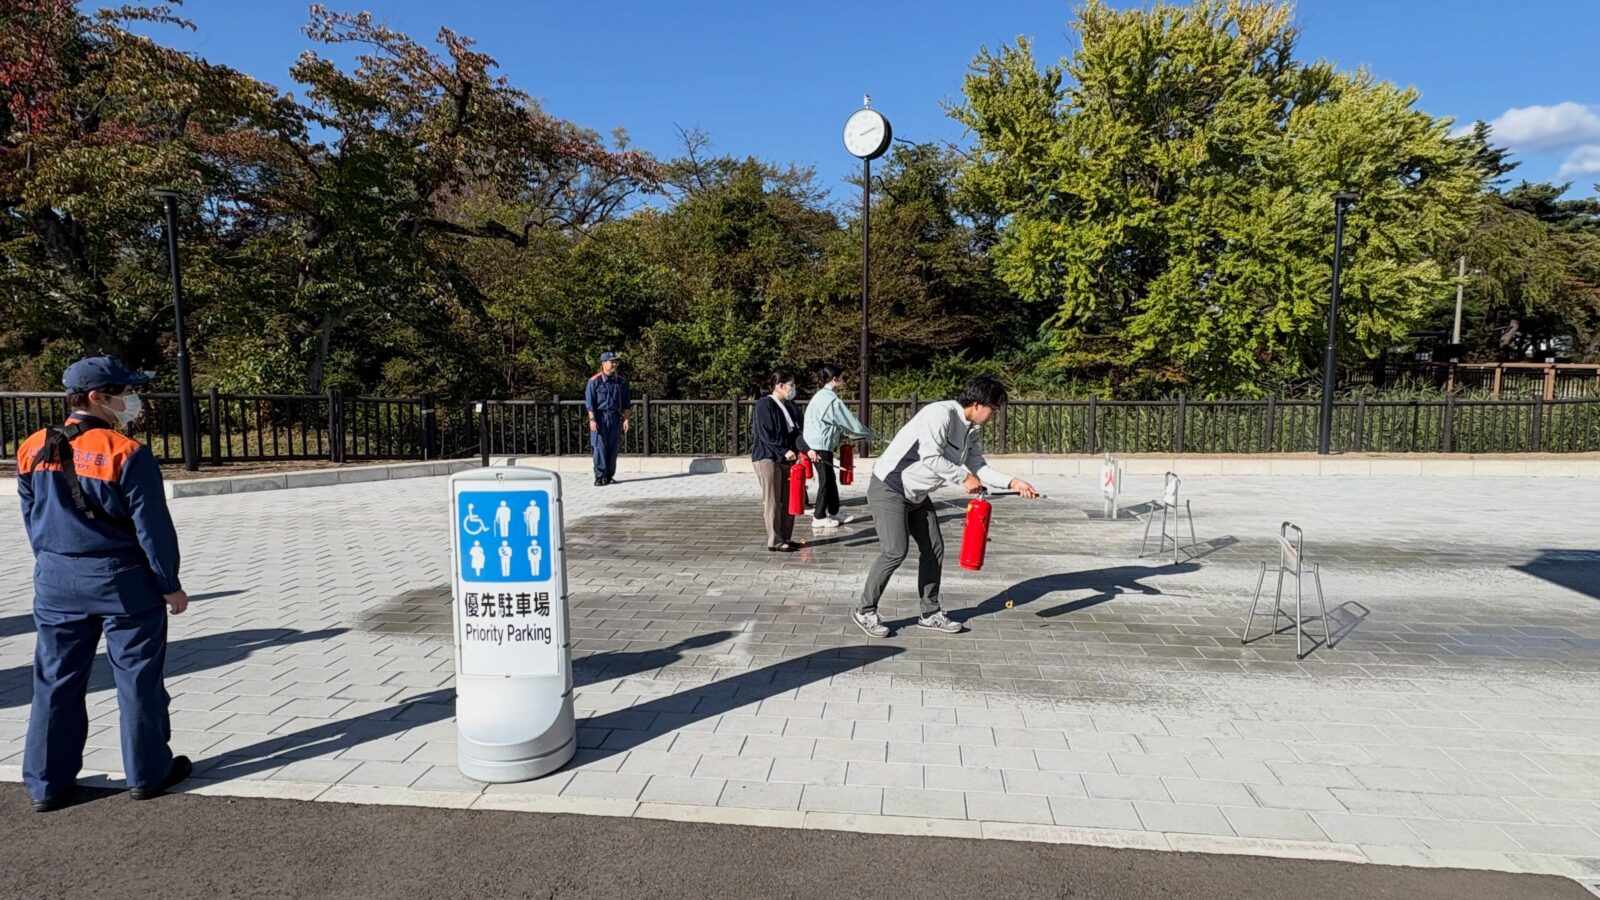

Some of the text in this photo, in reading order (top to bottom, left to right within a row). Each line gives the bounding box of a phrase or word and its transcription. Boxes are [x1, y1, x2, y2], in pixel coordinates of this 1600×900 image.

[464, 592, 551, 618] 優先駐車場
[465, 623, 552, 646] Priority Parking
